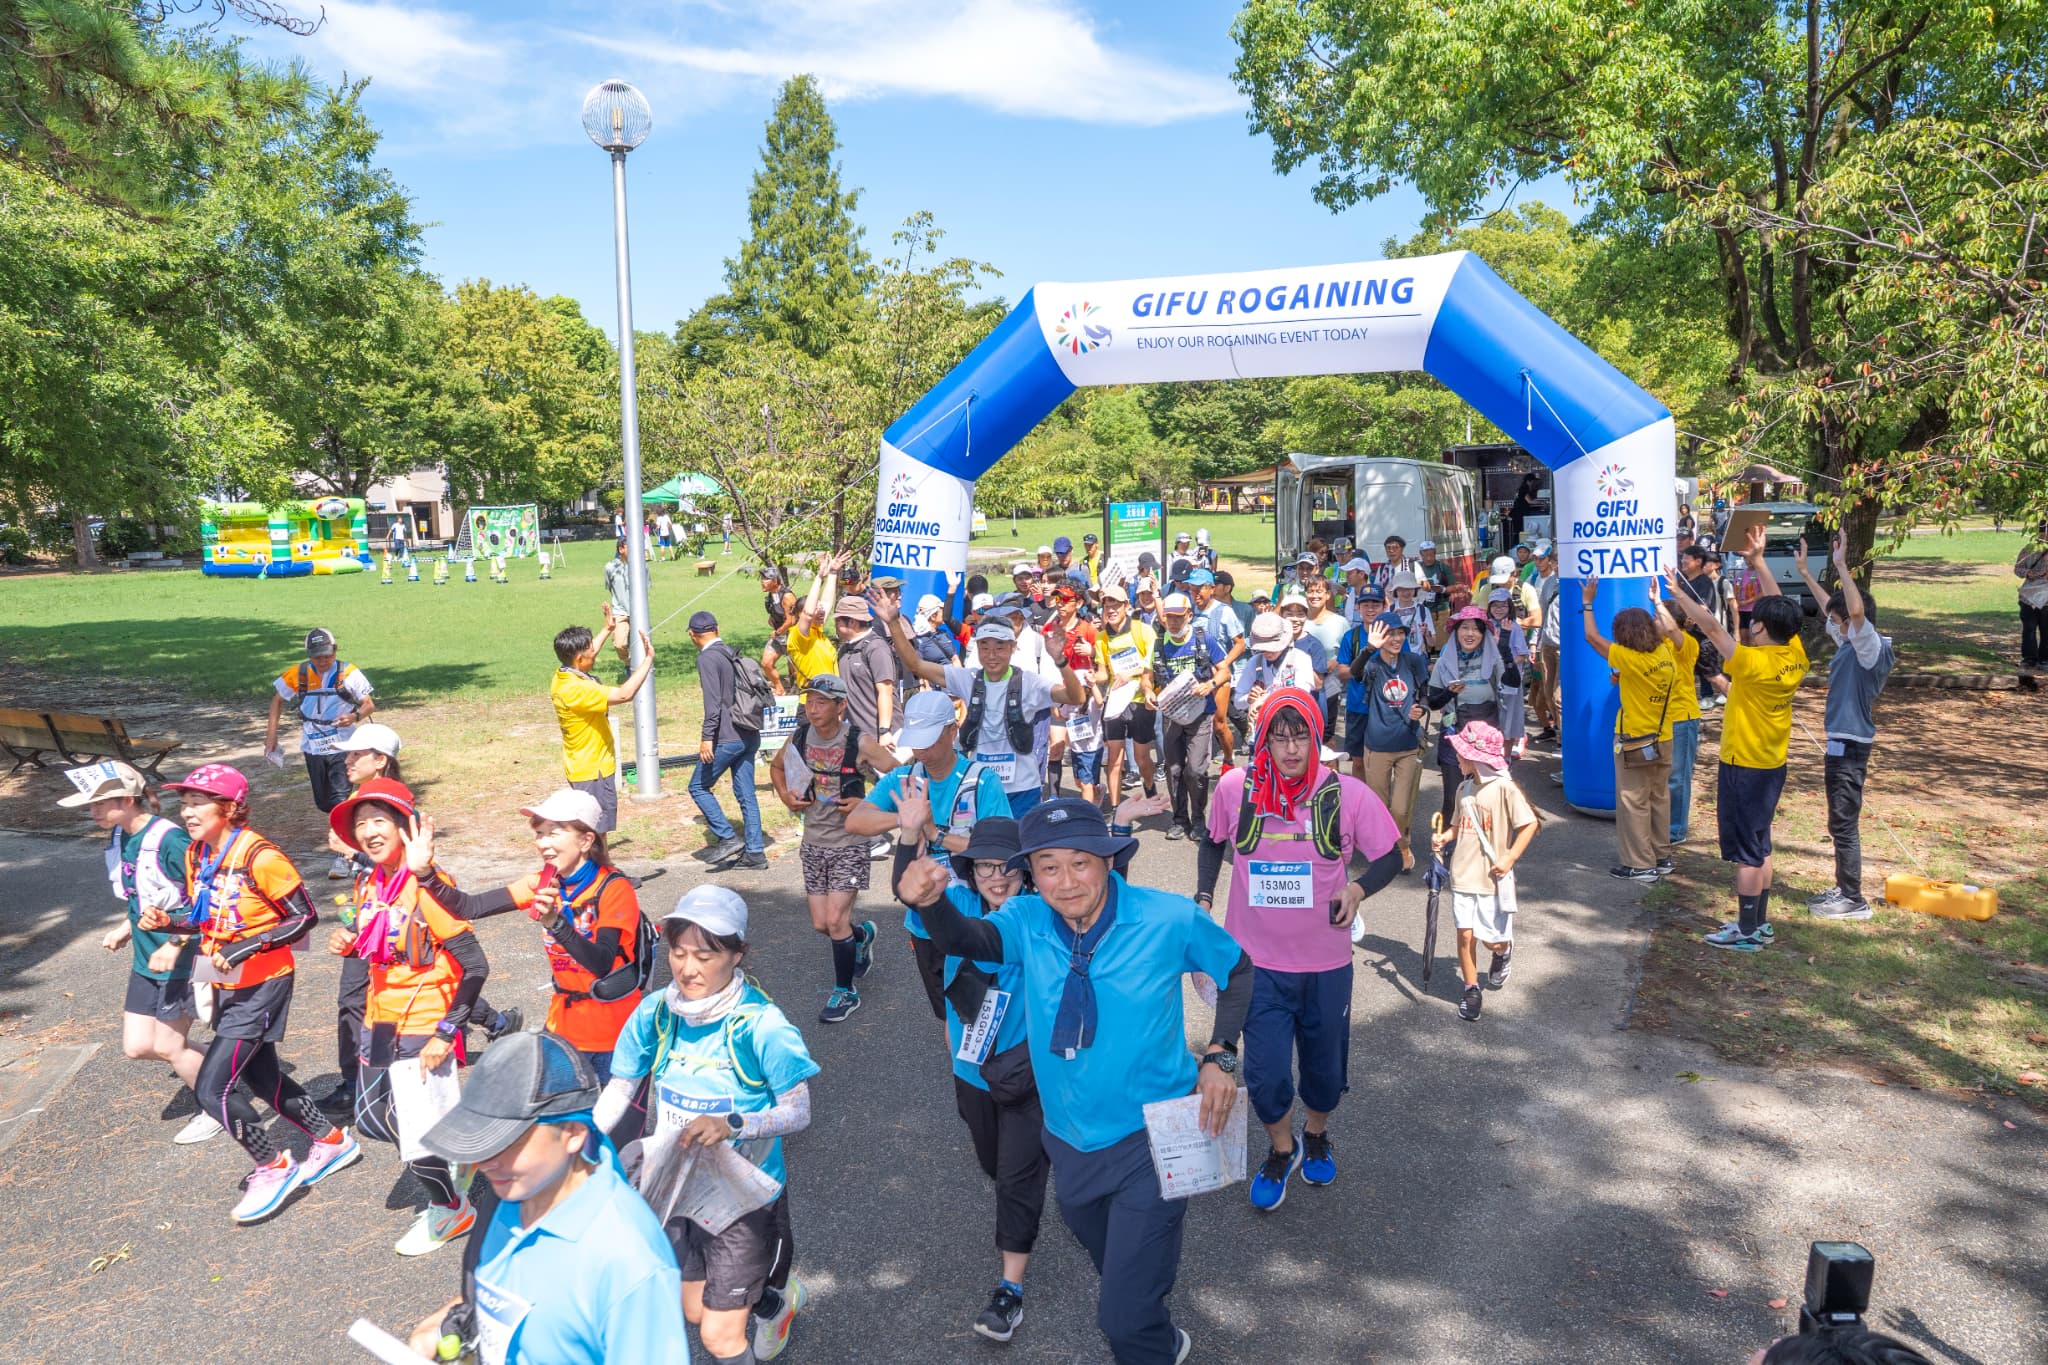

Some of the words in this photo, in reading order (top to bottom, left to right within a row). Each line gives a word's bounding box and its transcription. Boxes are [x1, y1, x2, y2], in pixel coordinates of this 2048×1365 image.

[1132, 290, 1209, 317] GIFU
[1216, 277, 1415, 315] ROGAINING
[1137, 336, 1174, 349] ENJOY
[1177, 335, 1204, 348] OUR
[1207, 332, 1278, 347] ROGAINING
[1280, 329, 1320, 344] EVENT
[1322, 327, 1369, 341] TODAY
[888, 502, 918, 518] GIFU
[1596, 499, 1638, 518] GIFU
[876, 518, 941, 536] ROGAINING
[1573, 517, 1664, 538] ROGAINING
[875, 541, 937, 567] START
[1577, 546, 1661, 575] START
[1260, 880, 1302, 891] 153M03
